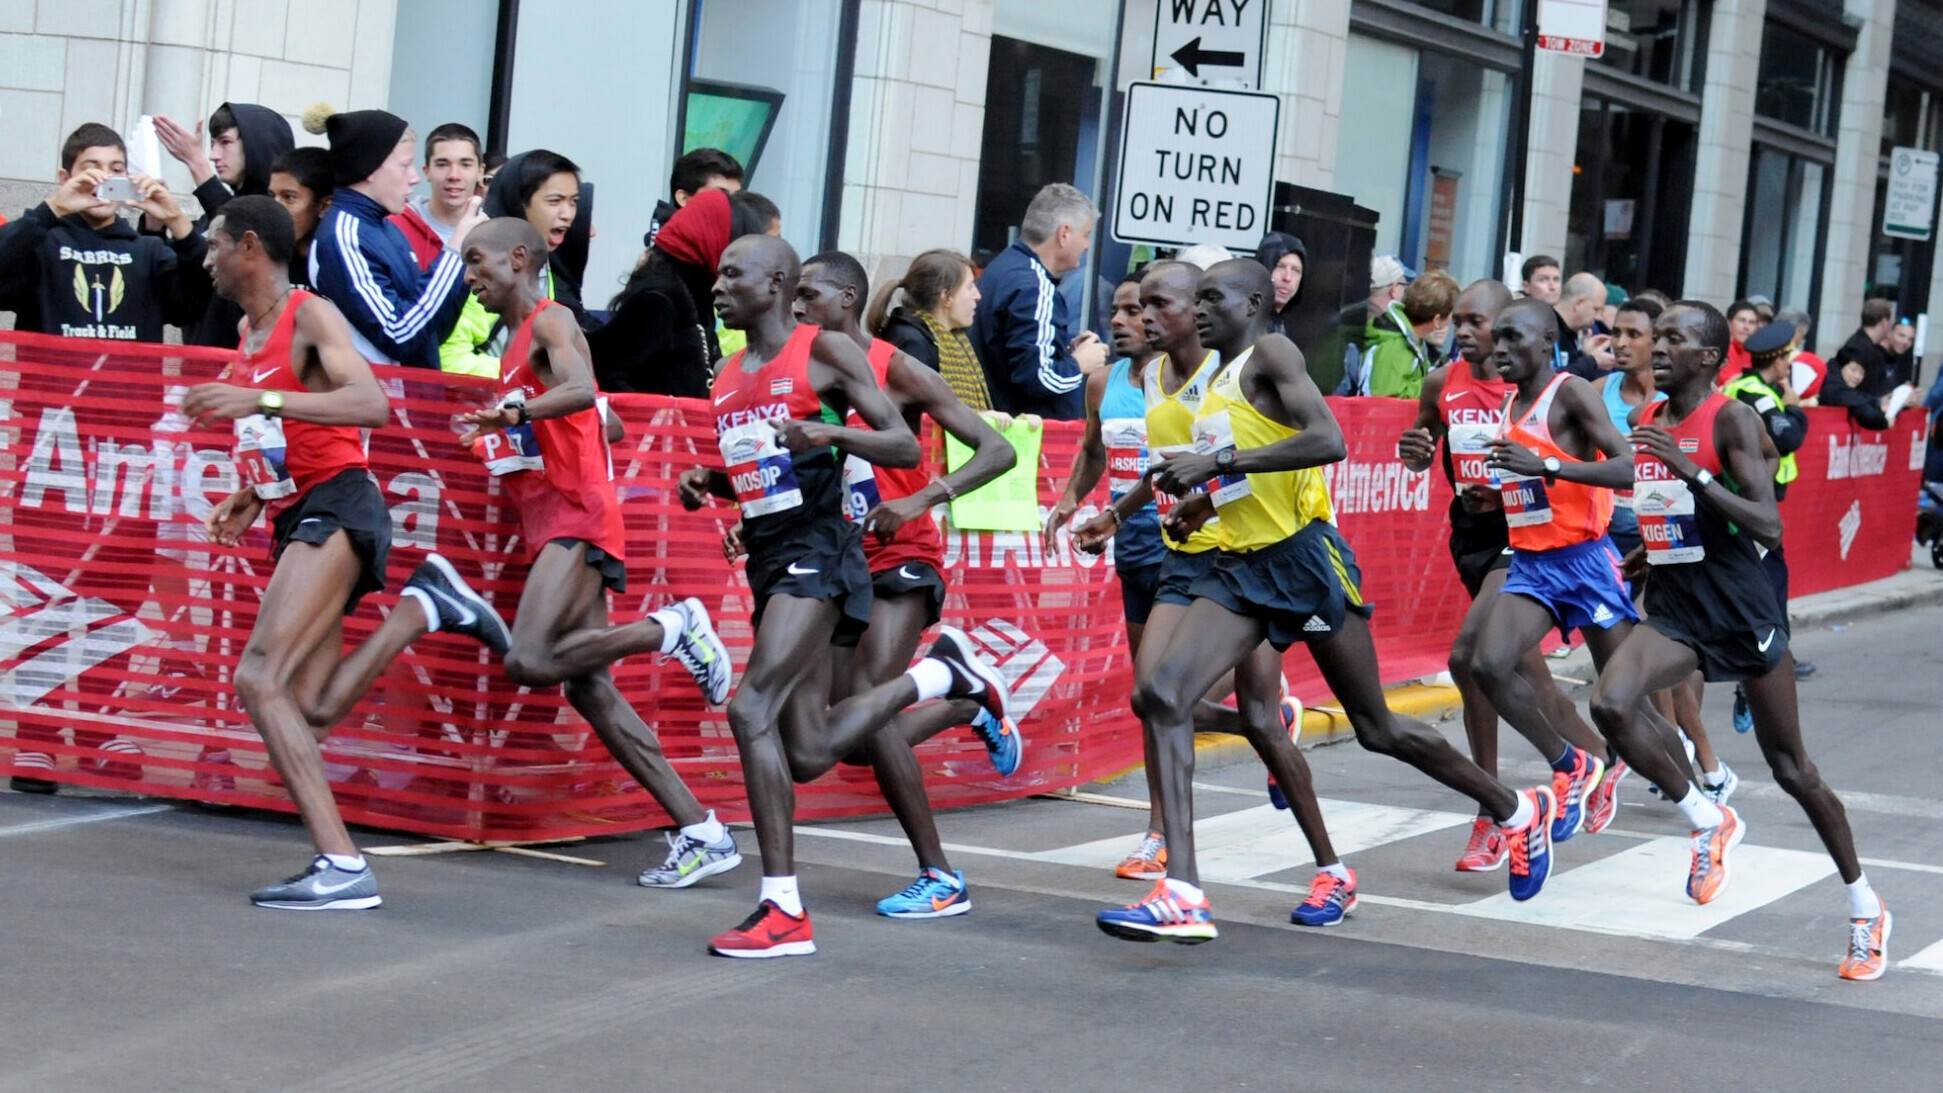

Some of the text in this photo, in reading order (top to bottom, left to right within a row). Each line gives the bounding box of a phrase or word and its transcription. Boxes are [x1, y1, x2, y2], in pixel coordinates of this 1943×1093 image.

[1171, 0, 1250, 26] WAY
[1175, 107, 1228, 138] NO
[1155, 150, 1241, 185] TURN
[1130, 192, 1255, 231] ON RED
[59, 246, 133, 265] SABRES
[61, 323, 137, 340] Track & Field
[716, 402, 791, 436] KENYA
[731, 465, 782, 495] MOSOP
[1502, 487, 1536, 507] MUTAI
[1642, 523, 1685, 542] KIGEN
